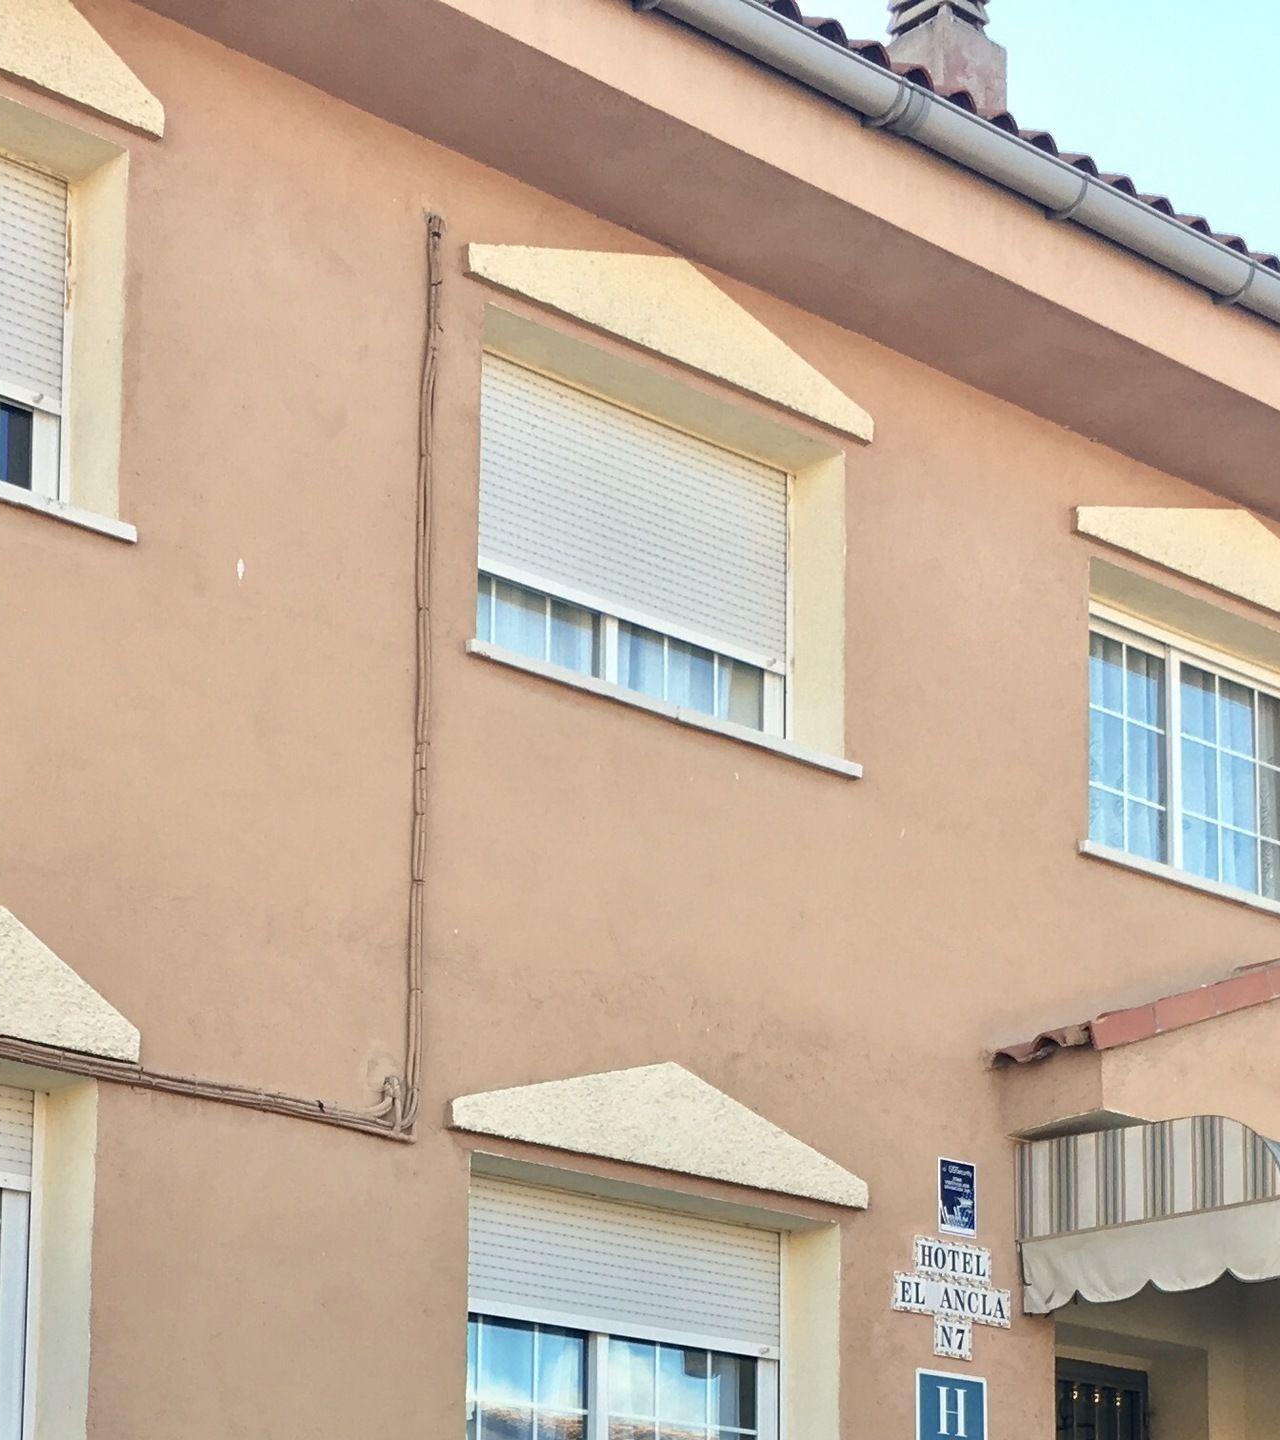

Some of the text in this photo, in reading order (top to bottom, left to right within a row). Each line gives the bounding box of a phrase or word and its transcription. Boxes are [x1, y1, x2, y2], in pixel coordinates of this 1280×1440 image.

[920, 1244, 986, 1277] HOTEL
[900, 1280, 1006, 1320] EL ANCLA
[940, 1325, 965, 1350] N7
[936, 1385, 968, 1438] H
